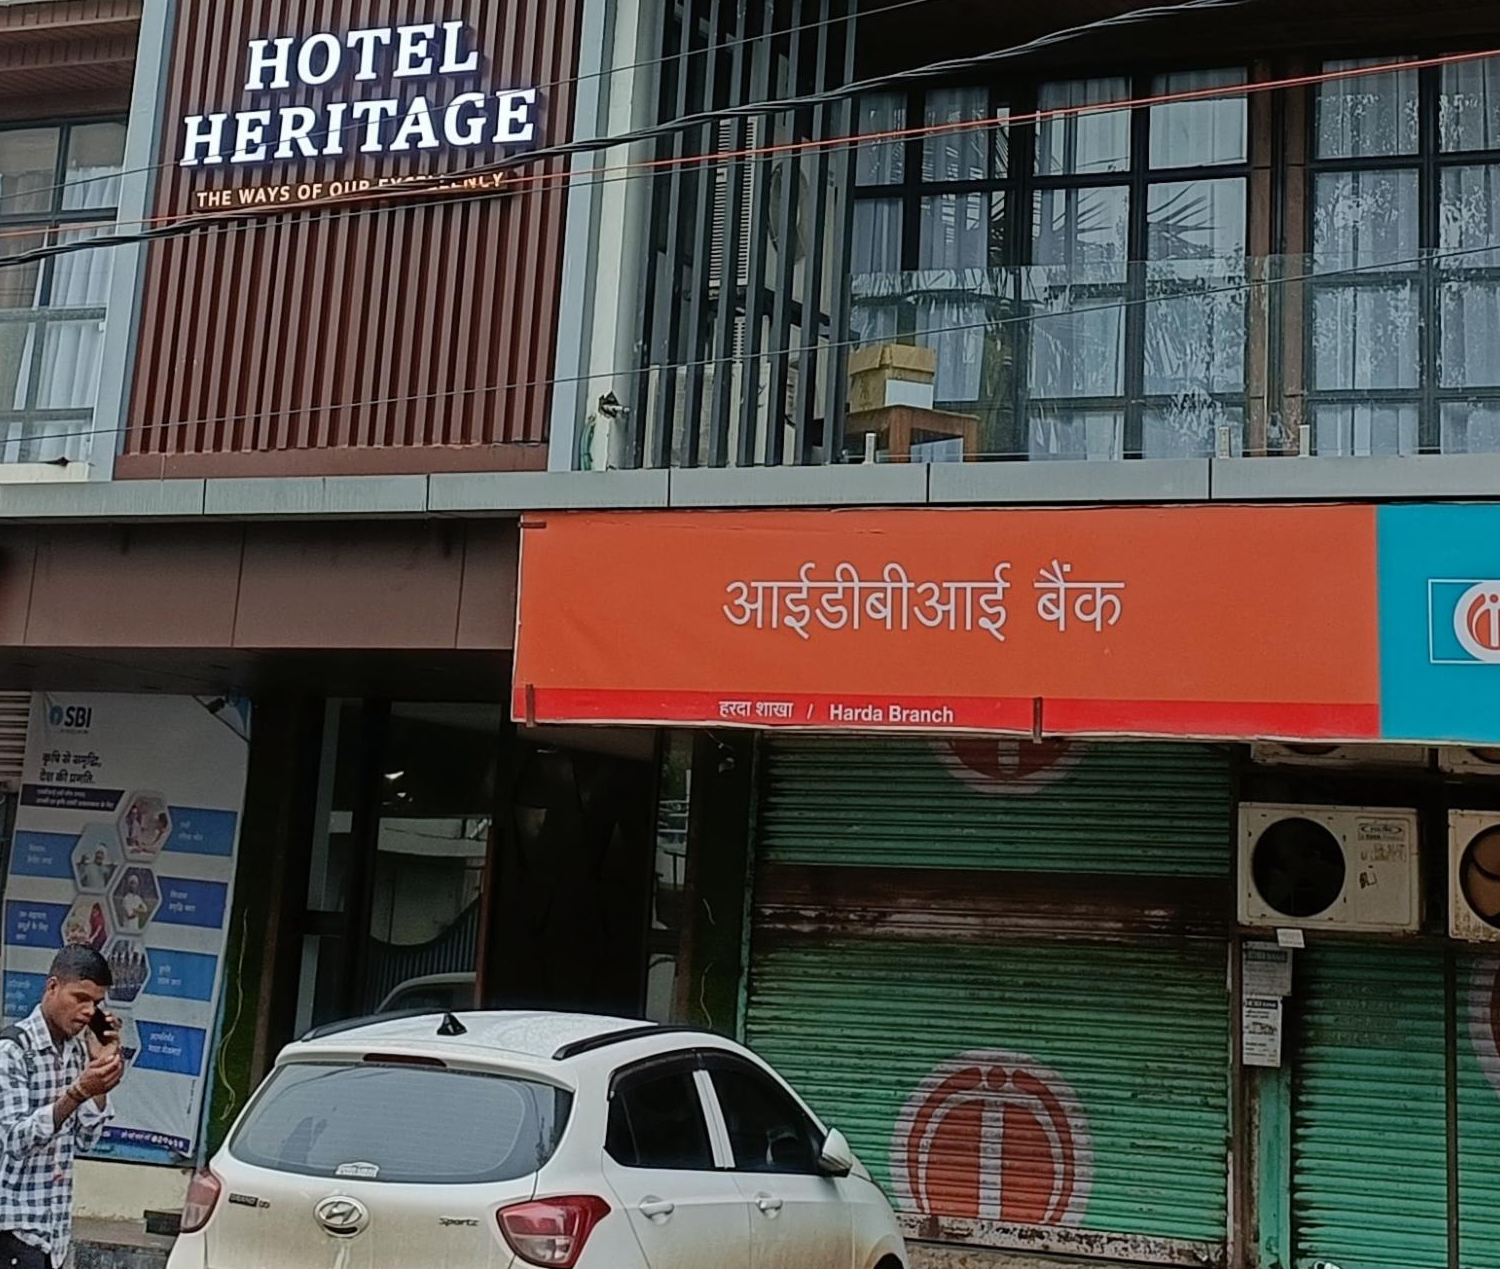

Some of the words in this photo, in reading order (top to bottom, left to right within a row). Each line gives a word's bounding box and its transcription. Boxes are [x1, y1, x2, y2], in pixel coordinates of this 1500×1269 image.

[243, 20, 479, 92] HOTEL
[179, 88, 537, 167] HERITAGE
[197, 190, 232, 208] THE
[238, 186, 291, 205] WAYS
[297, 183, 323, 200] OF
[722, 562, 1012, 641] आईडीबीआई
[1034, 559, 1126, 632] बैंक
[64, 706, 92, 728] SBI
[718, 700, 752, 718] हरदा
[755, 700, 794, 719] शाखा
[829, 703, 884, 723] Harda
[888, 705, 954, 724] Branch
